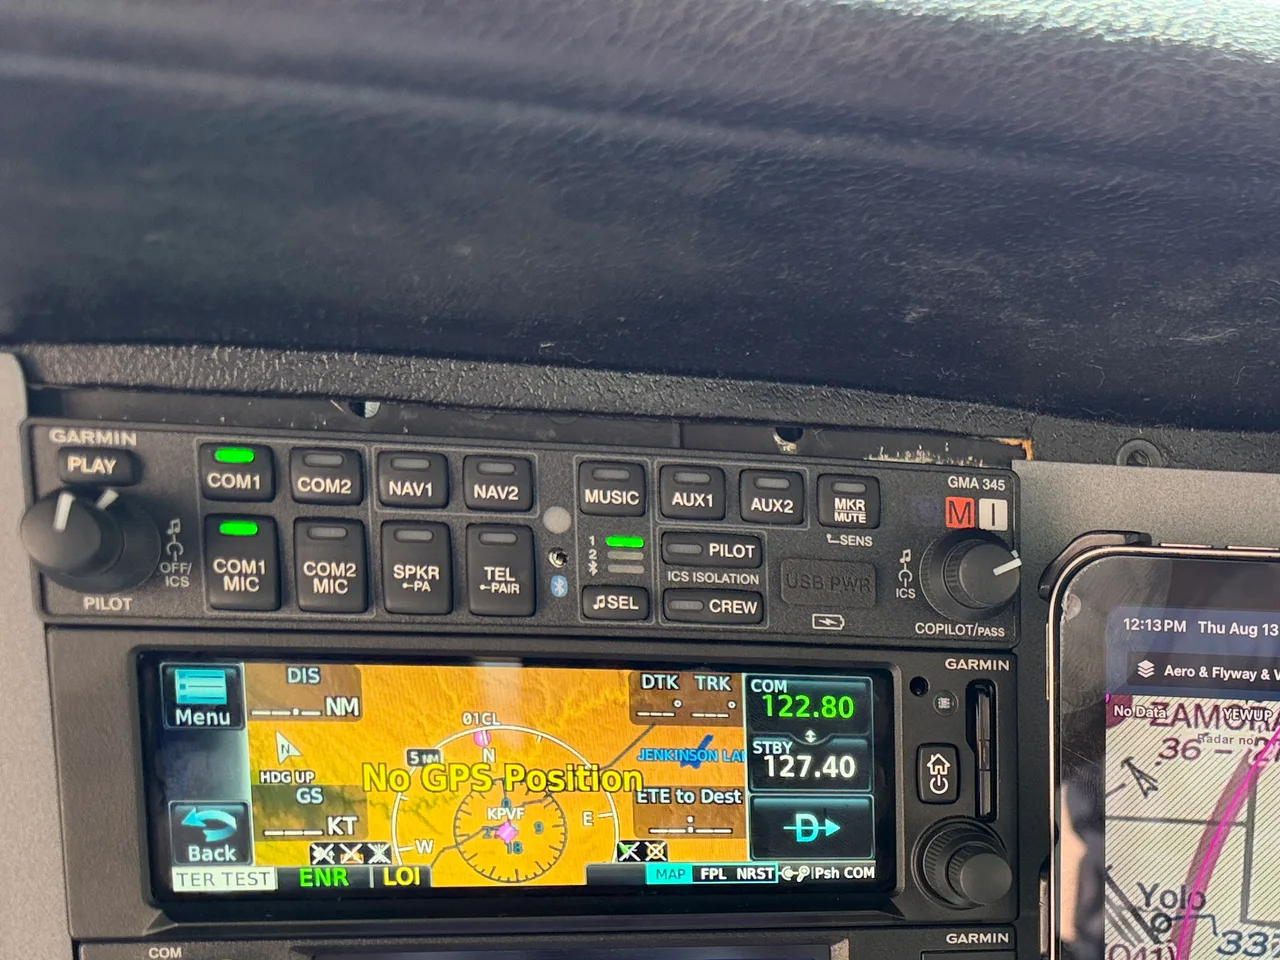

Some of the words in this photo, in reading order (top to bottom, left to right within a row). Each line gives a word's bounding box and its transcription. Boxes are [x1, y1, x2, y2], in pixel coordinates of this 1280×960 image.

[49, 428, 137, 446] GARMIN
[67, 457, 117, 475] PLAY
[207, 472, 262, 490] COM1
[297, 477, 353, 495] COM2
[388, 480, 434, 498] NAV1
[947, 475, 980, 491] GMA
[982, 477, 1005, 492] 345
[473, 484, 519, 501] NAV2
[584, 488, 640, 506] MUSIC
[671, 492, 714, 508] AUX1
[750, 497, 794, 514] AUX2
[708, 543, 756, 559] PILOT
[213, 558, 266, 577] COM1
[303, 560, 357, 578] COM2
[393, 563, 439, 581] SPKR
[484, 566, 516, 582] TEL
[223, 575, 260, 593] MIC
[313, 577, 349, 595] MIC
[83, 596, 132, 611] PILOT
[709, 600, 757, 615] CREW
[1198, 621, 1225, 636] Thu
[1229, 622, 1258, 638] Aug
[1262, 622, 1279, 636] 13
[944, 658, 1010, 672] GARMIN
[287, 667, 320, 685] DIS
[642, 674, 679, 690] DTK
[1164, 665, 1196, 679] Aero
[1198, 667, 1208, 679] &
[1211, 667, 1257, 683] Flyway
[1260, 669, 1271, 682] &
[694, 675, 732, 692] TRK
[750, 679, 788, 694] COM
[763, 694, 855, 720] 122.80
[1222, 708, 1272, 722] YEWUP
[175, 709, 231, 727] Menu
[752, 740, 792, 757] STBY
[763, 755, 856, 780] 127.40
[362, 763, 409, 792] No
[420, 763, 493, 793] GPS
[504, 763, 644, 793] Position
[296, 788, 324, 805] GS
[188, 844, 237, 863] Back
[176, 871, 219, 888] TER
[222, 871, 271, 887] TEST
[299, 868, 349, 887] ENR
[655, 867, 686, 881] MAP
[736, 867, 775, 881] NRST
[946, 932, 1009, 945] GARMIN
